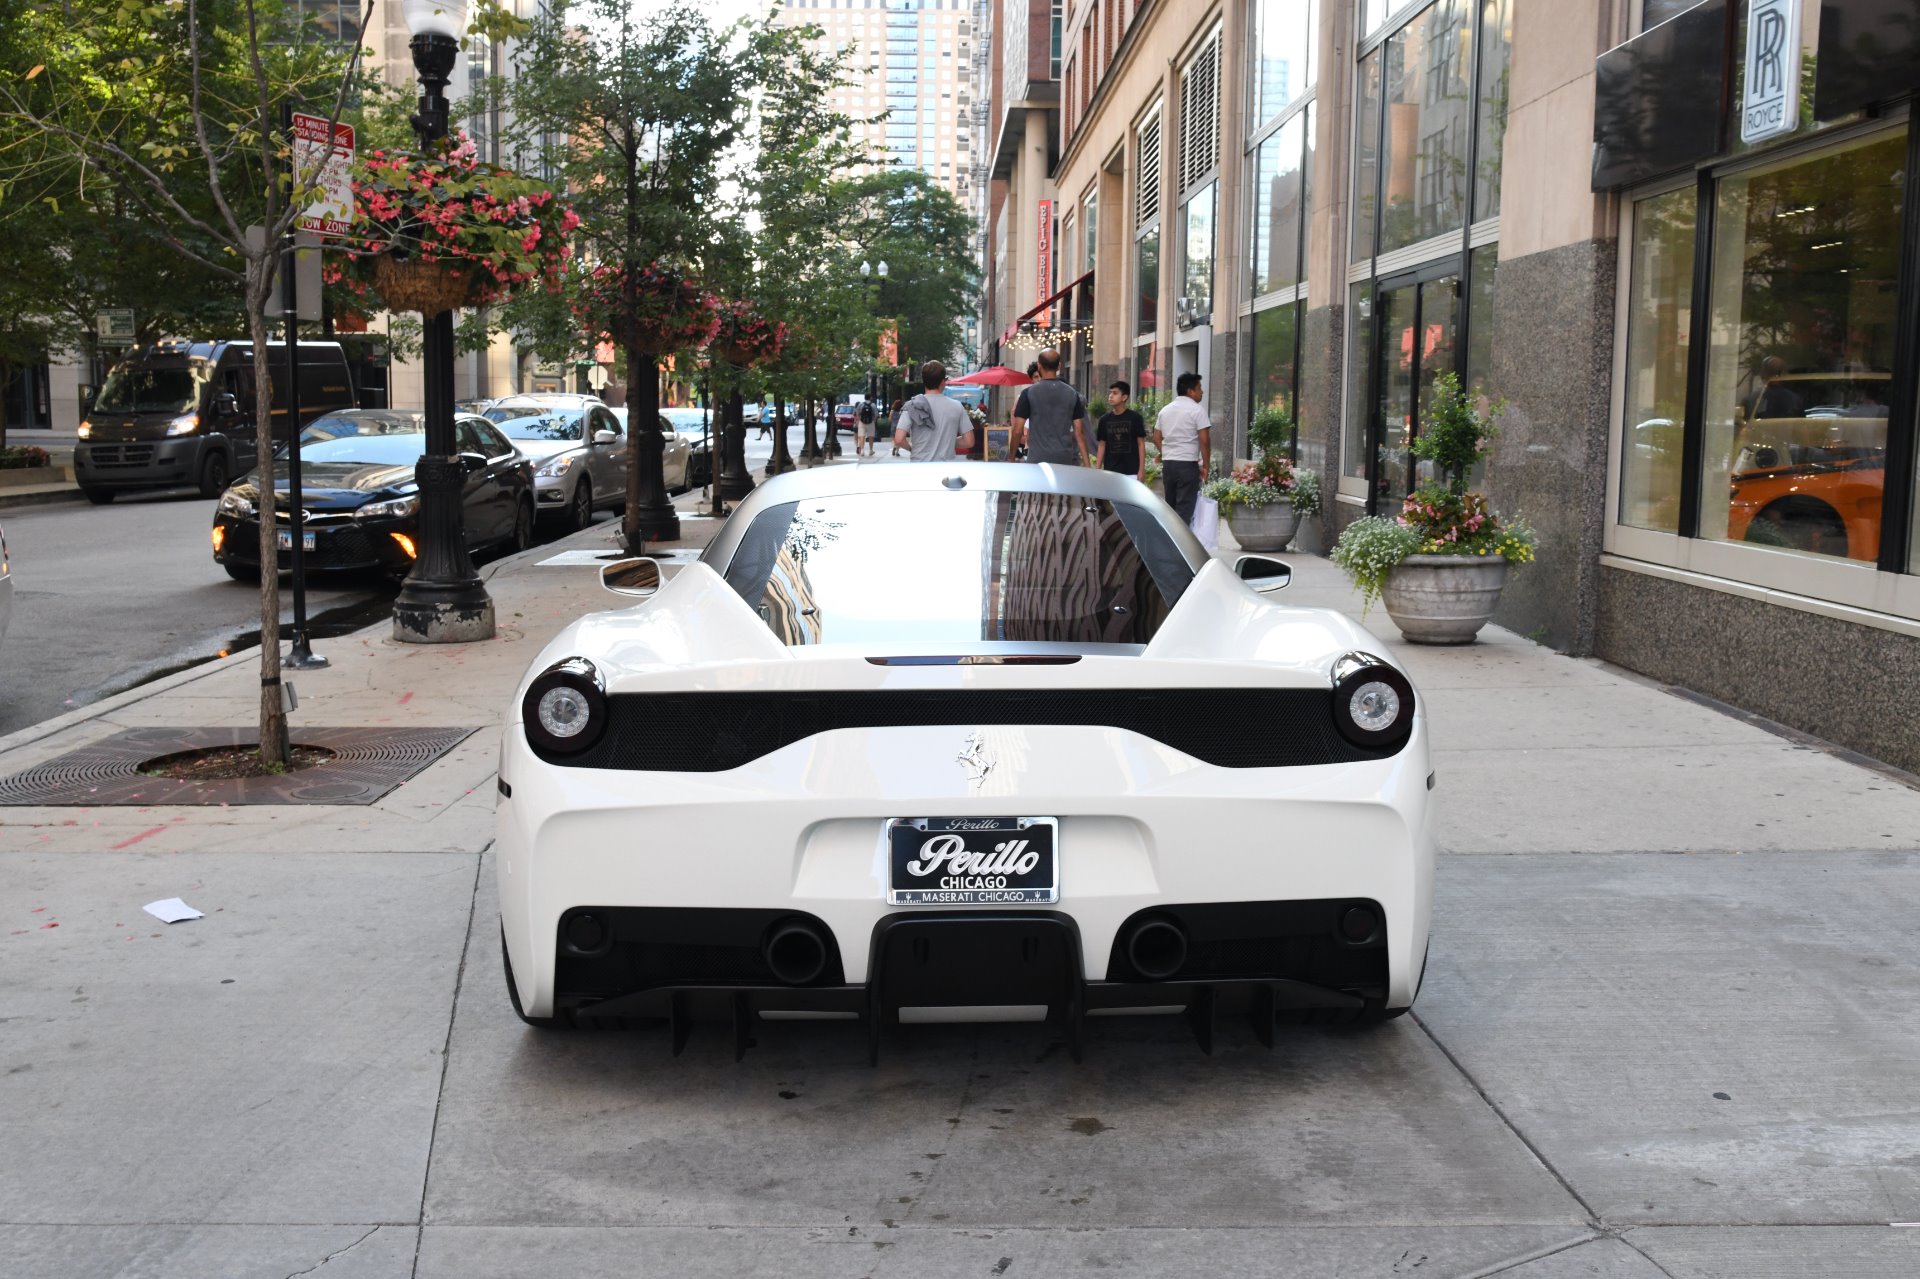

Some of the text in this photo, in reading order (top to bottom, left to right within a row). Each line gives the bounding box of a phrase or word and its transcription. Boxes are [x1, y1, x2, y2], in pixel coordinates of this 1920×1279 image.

[1747, 102, 1783, 131] ROYCE
[297, 117, 330, 133] 15 MINUTE
[333, 135, 349, 147] ONE
[302, 218, 321, 231] OW
[1039, 205, 1048, 251] EPIC
[946, 818, 1000, 831] Perillo
[907, 834, 1040, 877] Perillo
[940, 876, 1007, 890] CHICAGO
[922, 891, 1025, 902] MASERATI CHICAGO
